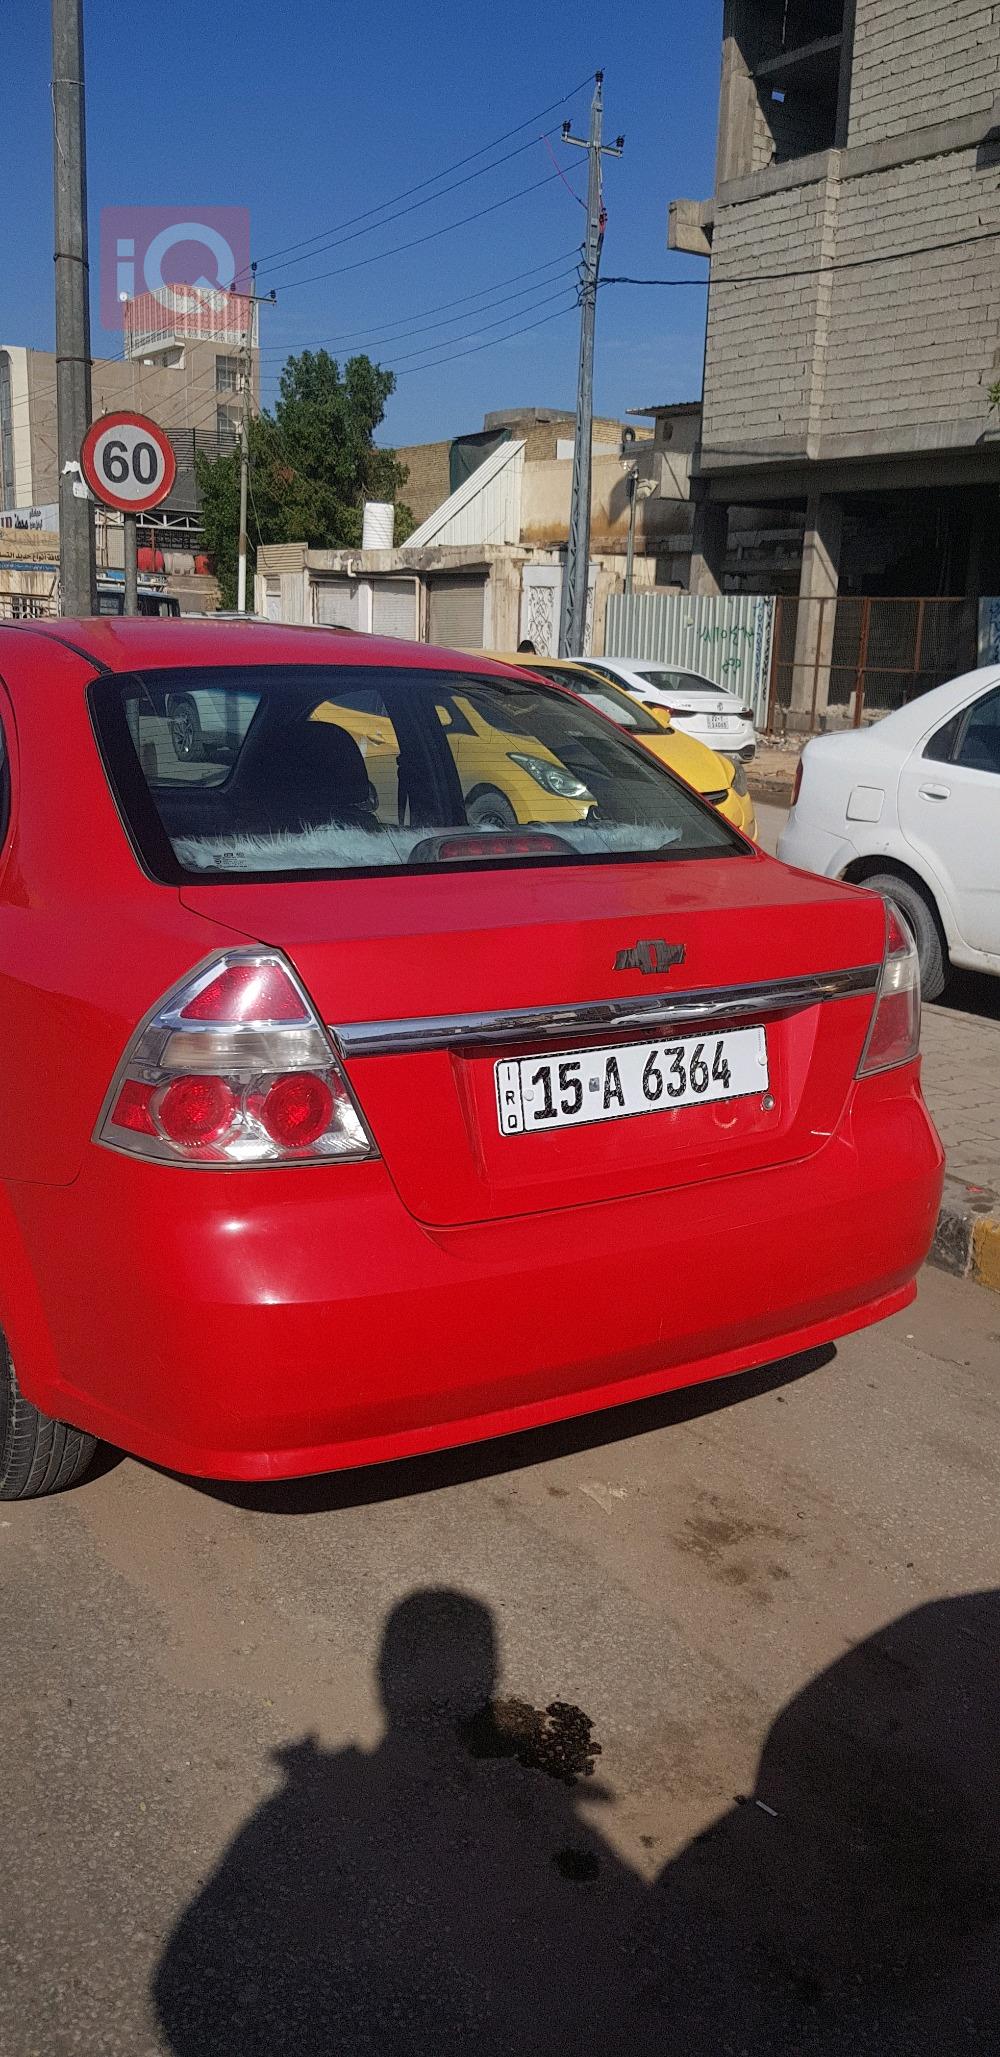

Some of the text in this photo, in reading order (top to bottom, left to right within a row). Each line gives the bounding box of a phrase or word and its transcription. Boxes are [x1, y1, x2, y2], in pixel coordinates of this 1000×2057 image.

[102, 440, 158, 485] 60
[505, 1066, 518, 1129] IRQ
[531, 1040, 732, 1120] 15 A 6364
